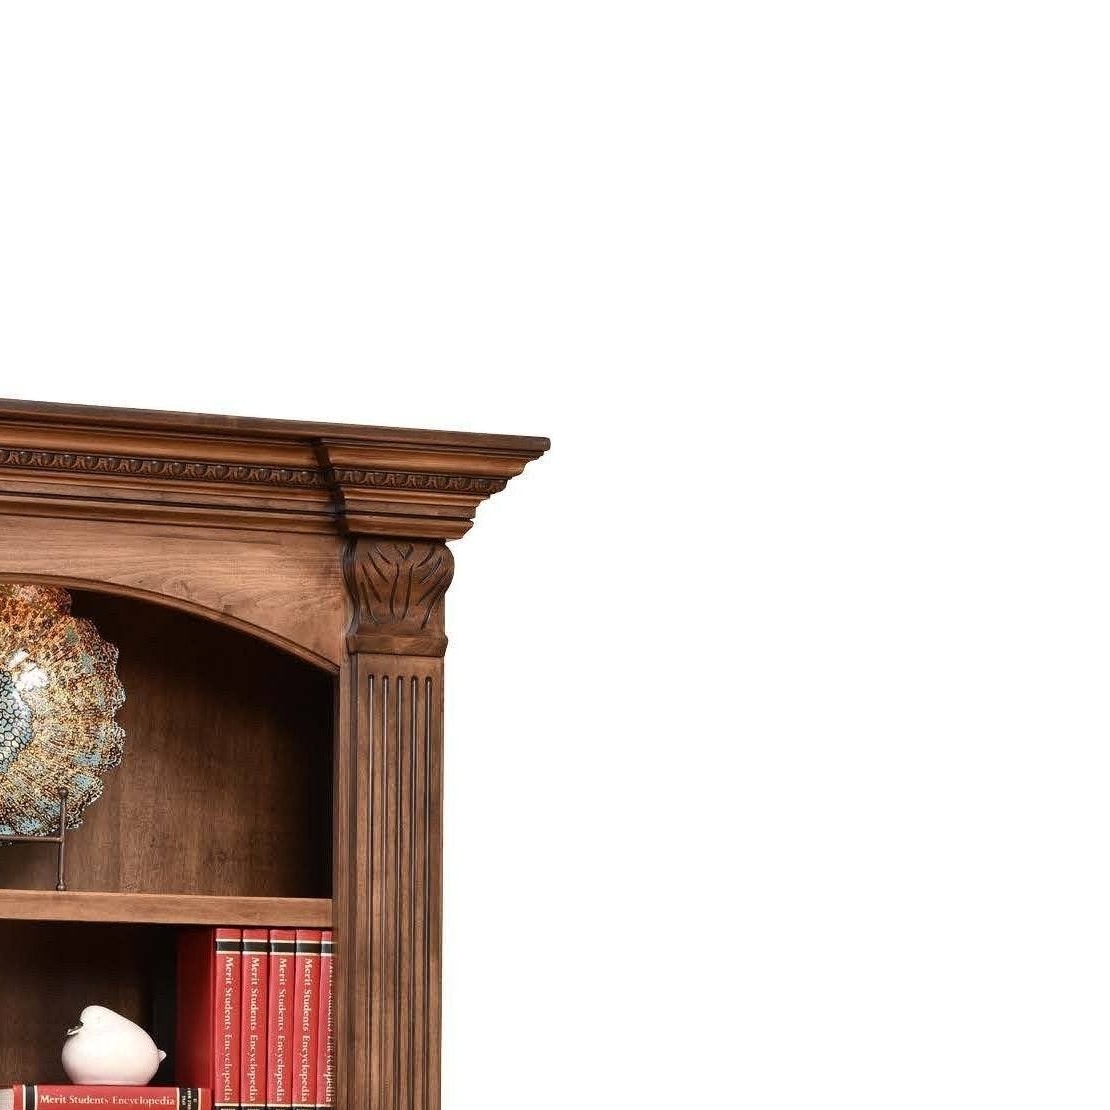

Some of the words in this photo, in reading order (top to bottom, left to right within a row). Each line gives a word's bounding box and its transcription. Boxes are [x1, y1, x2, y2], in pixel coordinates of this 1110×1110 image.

[225, 956, 235, 984] Merit
[250, 956, 261, 984] Merit
[278, 957, 288, 986] Merit
[303, 957, 314, 986] Merit
[224, 985, 234, 1032] Students
[250, 987, 260, 1032] Students
[277, 988, 288, 1032] Students
[302, 987, 312, 1033] Students
[223, 1034, 233, 1102] Encyclopedia
[247, 1034, 259, 1102] Encyclopedia
[274, 1034, 286, 1103] Encyclopedia
[298, 1034, 311, 1103] Encyclopedia
[39, 1094, 67, 1105] Merit
[68, 1094, 109, 1105] Students
[112, 1095, 176, 1108] Encyclopedia
